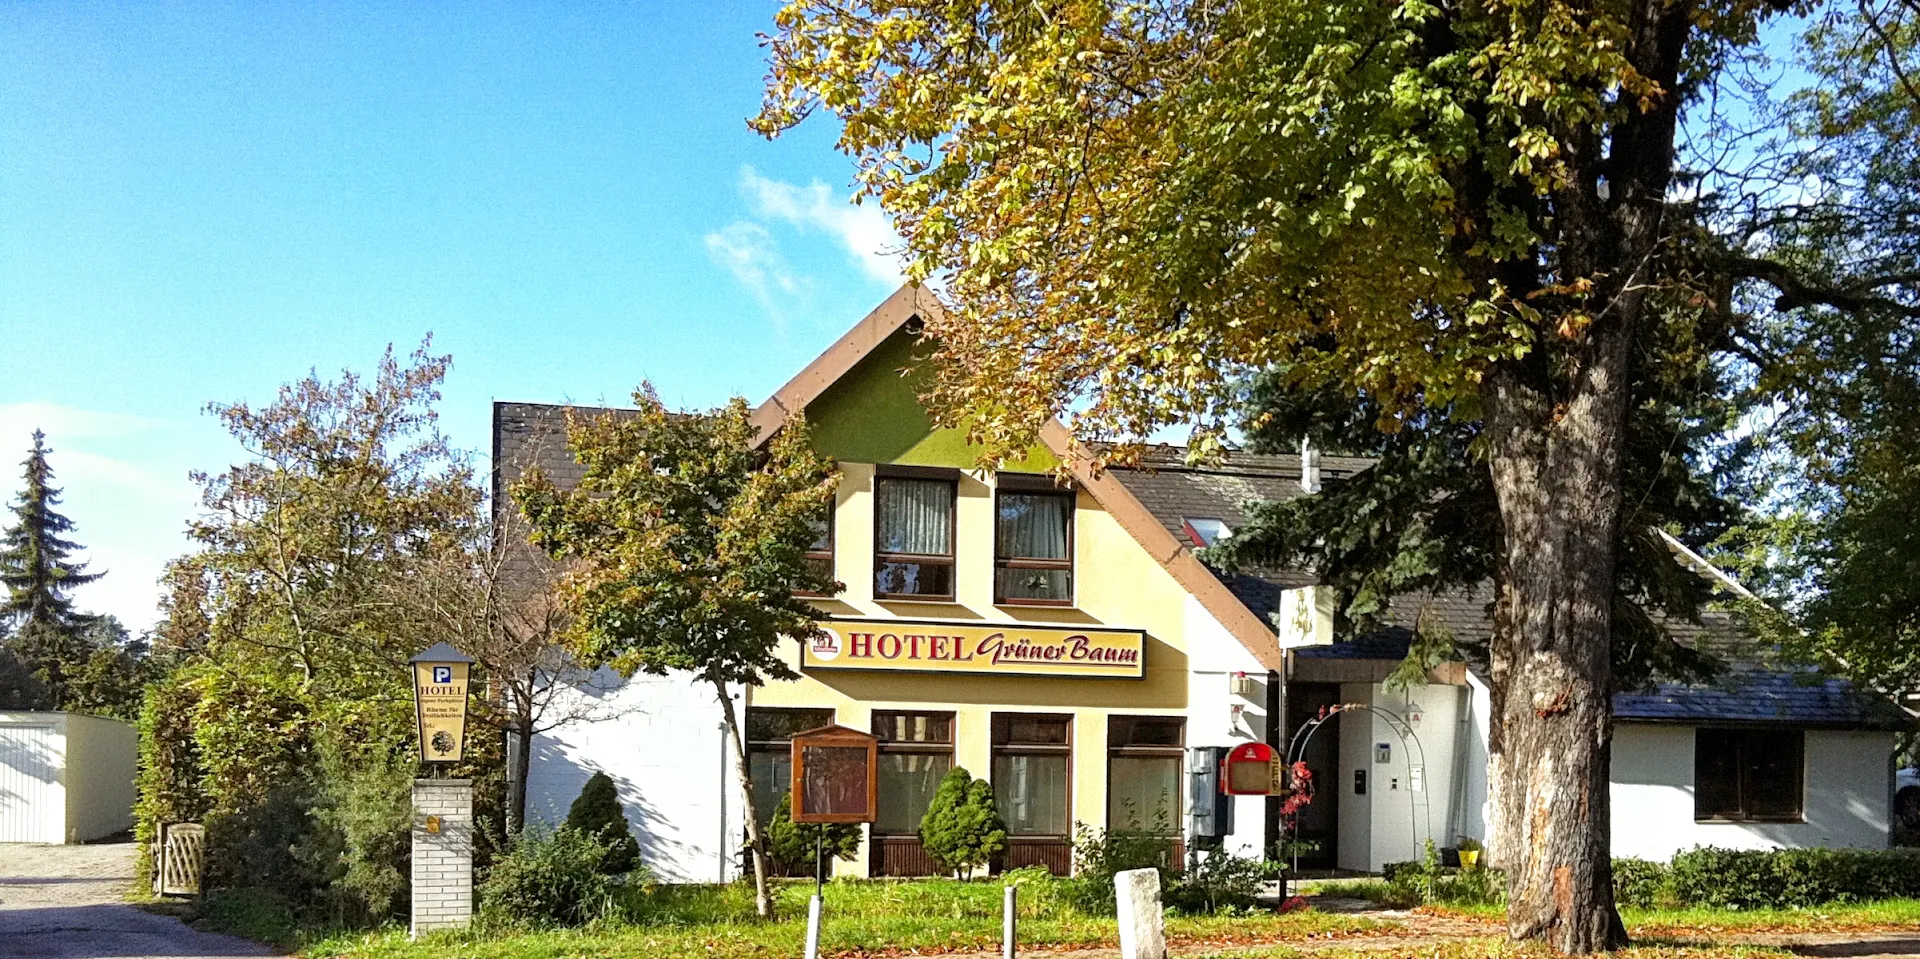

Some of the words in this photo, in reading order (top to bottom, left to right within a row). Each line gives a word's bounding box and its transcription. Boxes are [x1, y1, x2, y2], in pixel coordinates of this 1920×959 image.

[848, 632, 974, 662] HOTEL
[976, 632, 1067, 666] Grüner
[1063, 635, 1139, 663] Baum
[436, 668, 450, 682] P
[421, 686, 465, 695] HOTEL
